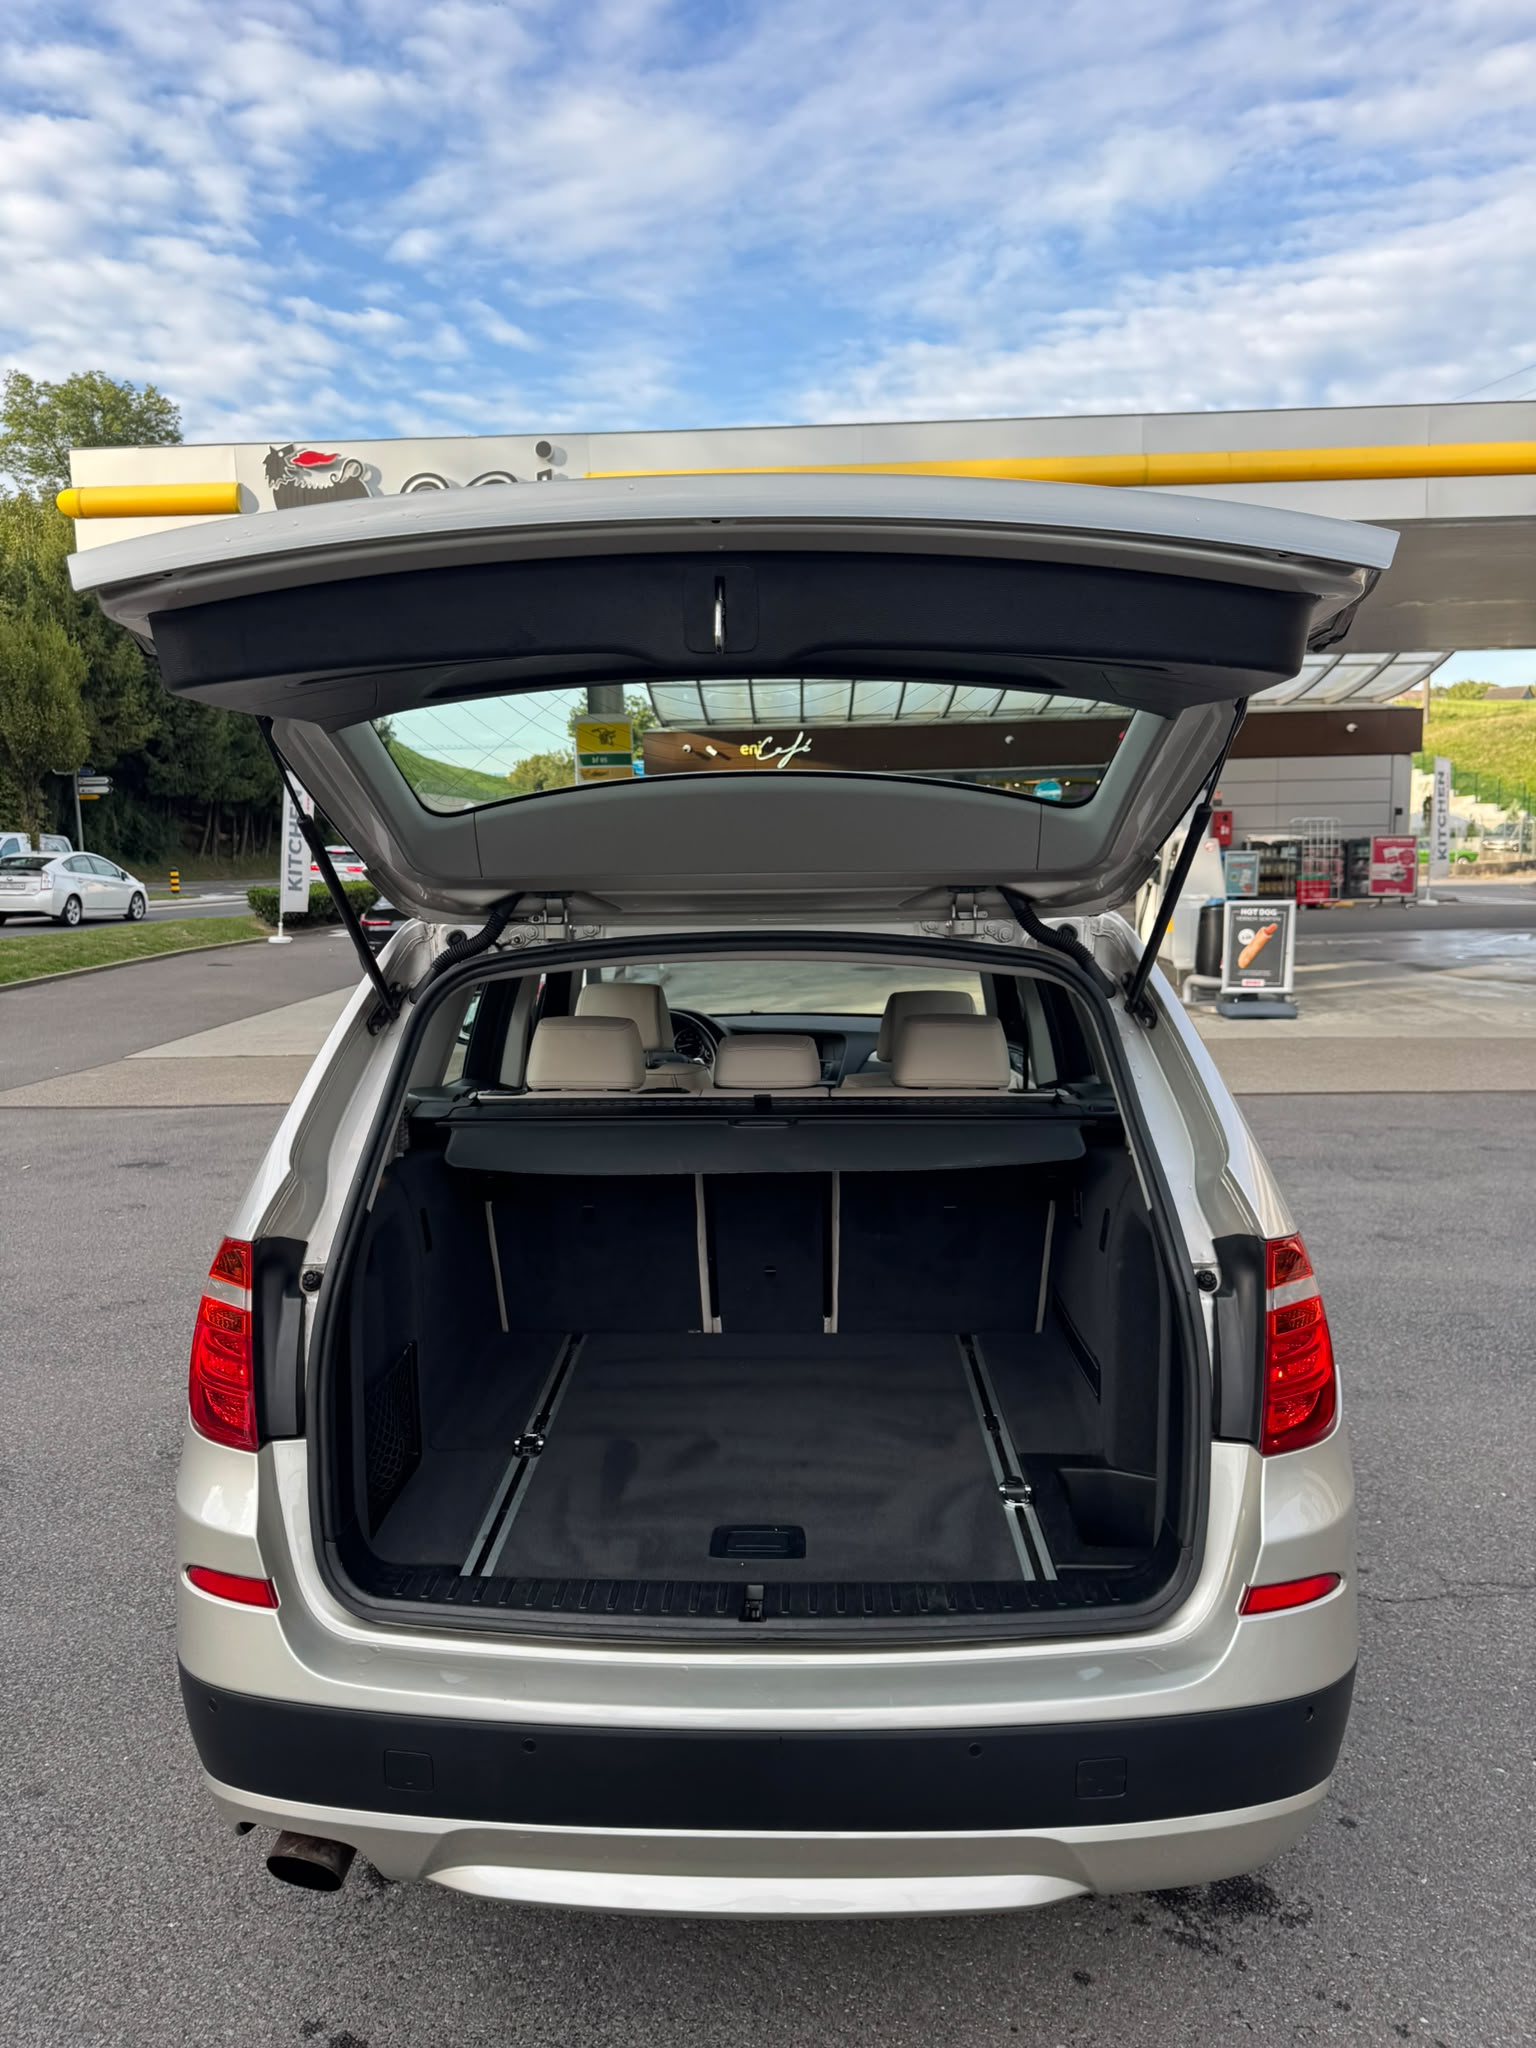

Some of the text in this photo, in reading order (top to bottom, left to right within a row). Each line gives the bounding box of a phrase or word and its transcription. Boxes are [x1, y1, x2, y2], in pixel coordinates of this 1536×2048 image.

[1437, 771, 1447, 860] KITCHEN
[1240, 908, 1278, 916] HOT DOG
